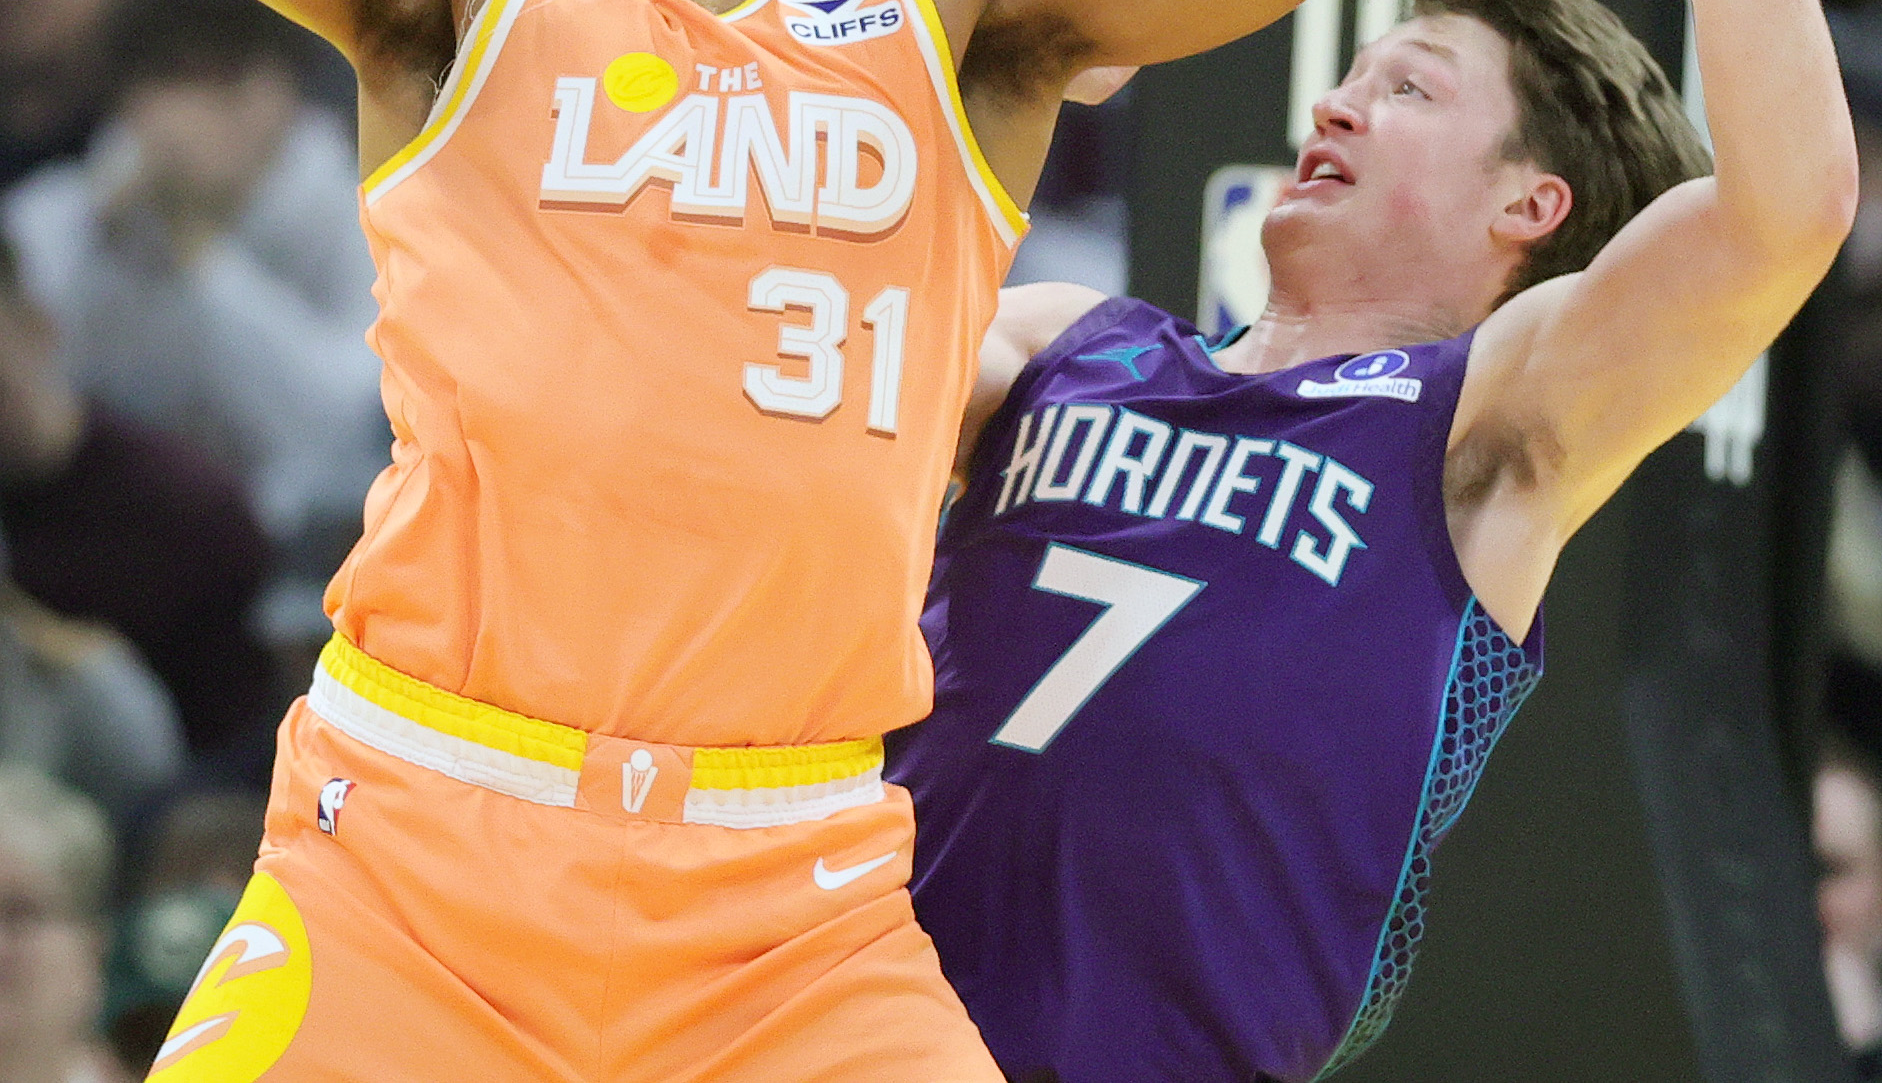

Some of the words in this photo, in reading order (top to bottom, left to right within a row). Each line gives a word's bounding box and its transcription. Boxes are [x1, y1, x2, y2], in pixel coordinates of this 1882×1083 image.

[695, 61, 762, 92] THE
[790, 7, 900, 40] CLIFFS
[538, 77, 918, 244] LAND
[743, 265, 910, 440] 31
[994, 403, 1375, 588] HORNETS
[988, 542, 1208, 754] 7
